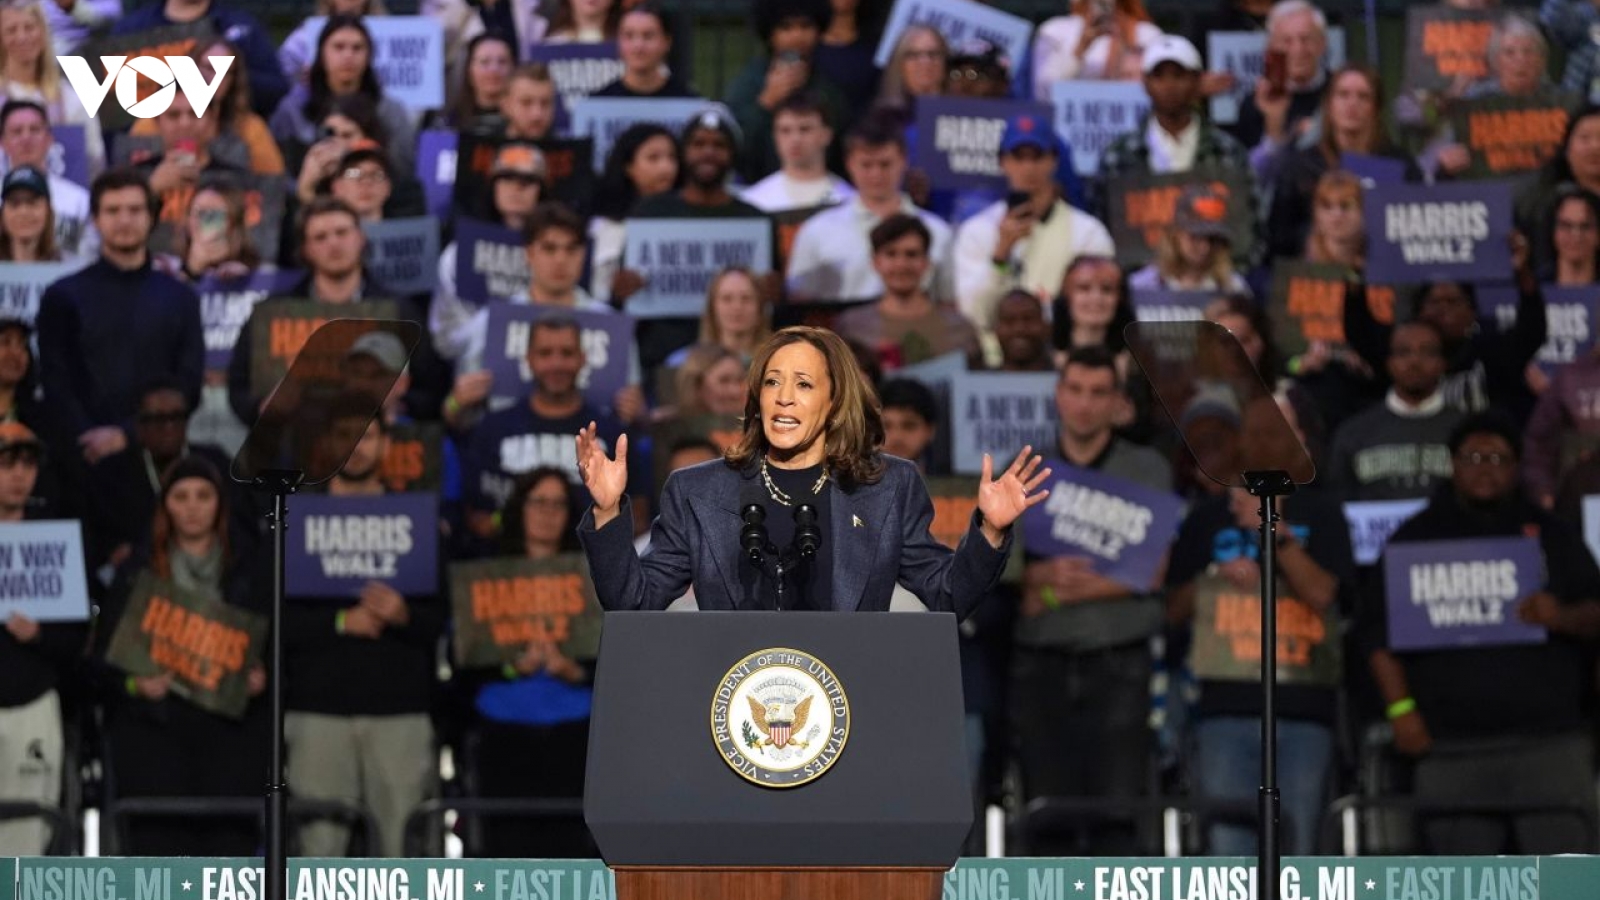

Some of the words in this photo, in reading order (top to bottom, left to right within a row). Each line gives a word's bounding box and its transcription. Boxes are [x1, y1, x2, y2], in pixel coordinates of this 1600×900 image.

[1386, 202, 1488, 238] HARRIS
[640, 240, 652, 265] A
[659, 240, 705, 265] NEW
[713, 239, 758, 266] WAY
[1400, 238, 1475, 265] WALZ
[966, 394, 981, 420] A
[987, 394, 1037, 421] NEW
[1044, 480, 1153, 546] HARRIS
[305, 515, 413, 555] HARRIS
[1051, 515, 1129, 562] WALZ
[22, 540, 67, 569] WAY
[321, 552, 398, 578] WALZ
[471, 573, 586, 621] HARRIS
[1410, 559, 1519, 604] HARRIS
[1426, 599, 1505, 628] WALZ
[140, 595, 250, 673] HARRIS
[757, 654, 774, 666] OF
[779, 653, 802, 666] THE
[715, 662, 751, 743] PRESIDENT
[809, 662, 846, 718] UNITED
[726, 749, 757, 779] VICE
[804, 727, 845, 776] STATES
[134, 868, 171, 900] MI
[427, 868, 463, 900] MI
[495, 869, 565, 900] EAST
[1028, 869, 1064, 900] MI
[1095, 867, 1165, 900] EAST
[1173, 867, 1311, 900] LANSIG,
[1318, 867, 1355, 900] MI
[1386, 867, 1455, 900] EAST
